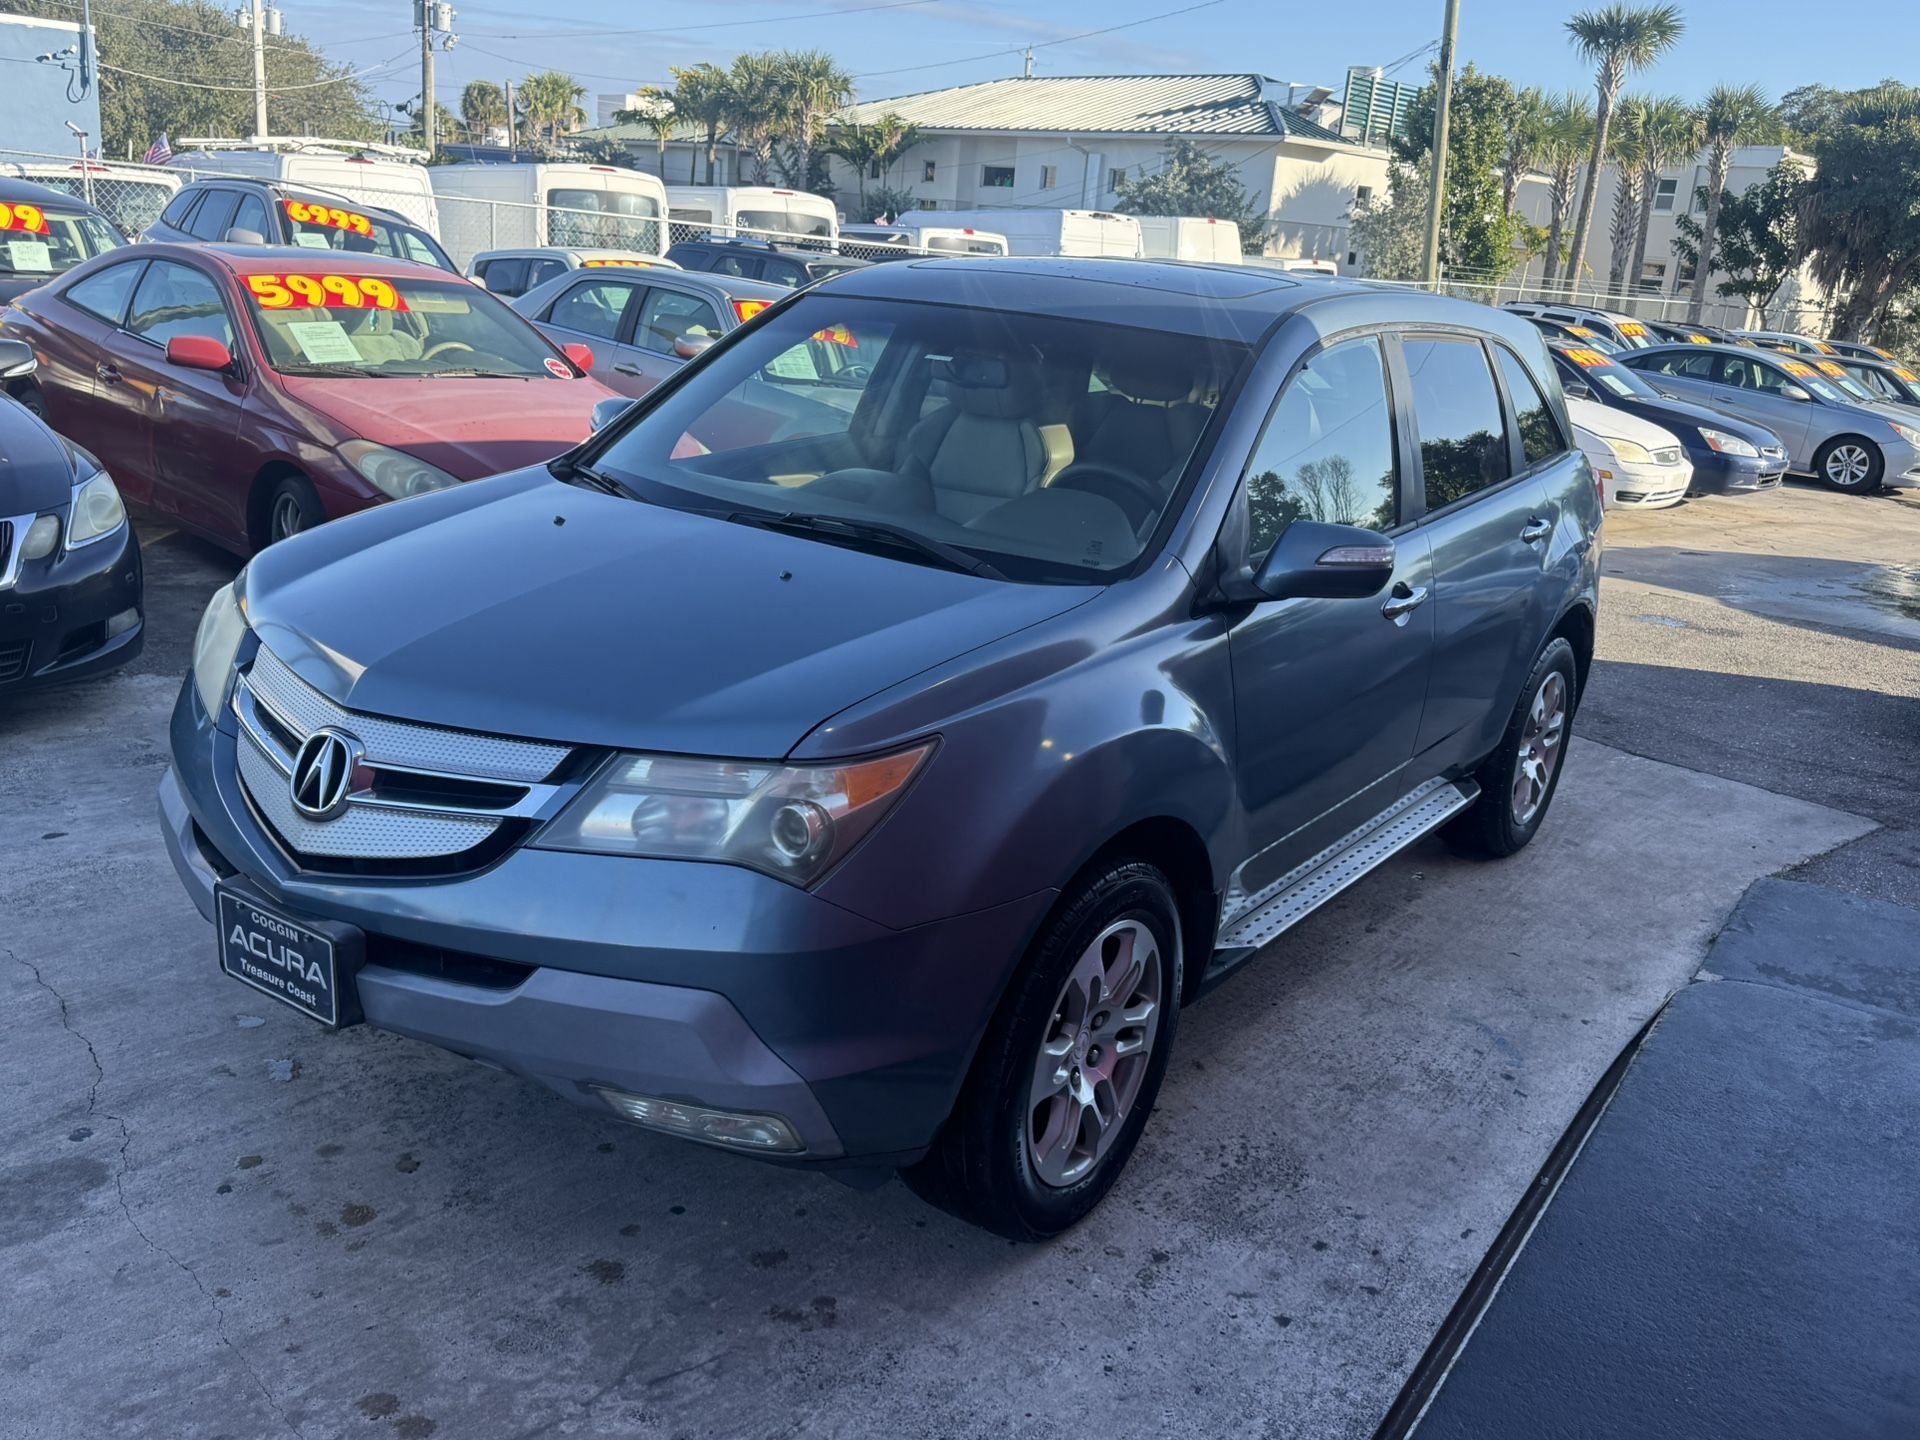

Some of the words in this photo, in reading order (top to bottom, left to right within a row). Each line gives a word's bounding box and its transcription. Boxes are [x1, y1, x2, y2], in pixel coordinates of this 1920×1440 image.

[287, 201, 372, 235] 6999
[248, 275, 399, 309] 5999
[251, 911, 299, 943] COGGIN
[229, 925, 328, 990] ACURA
[240, 957, 285, 989] Treasure
[287, 981, 317, 1006] Coast
